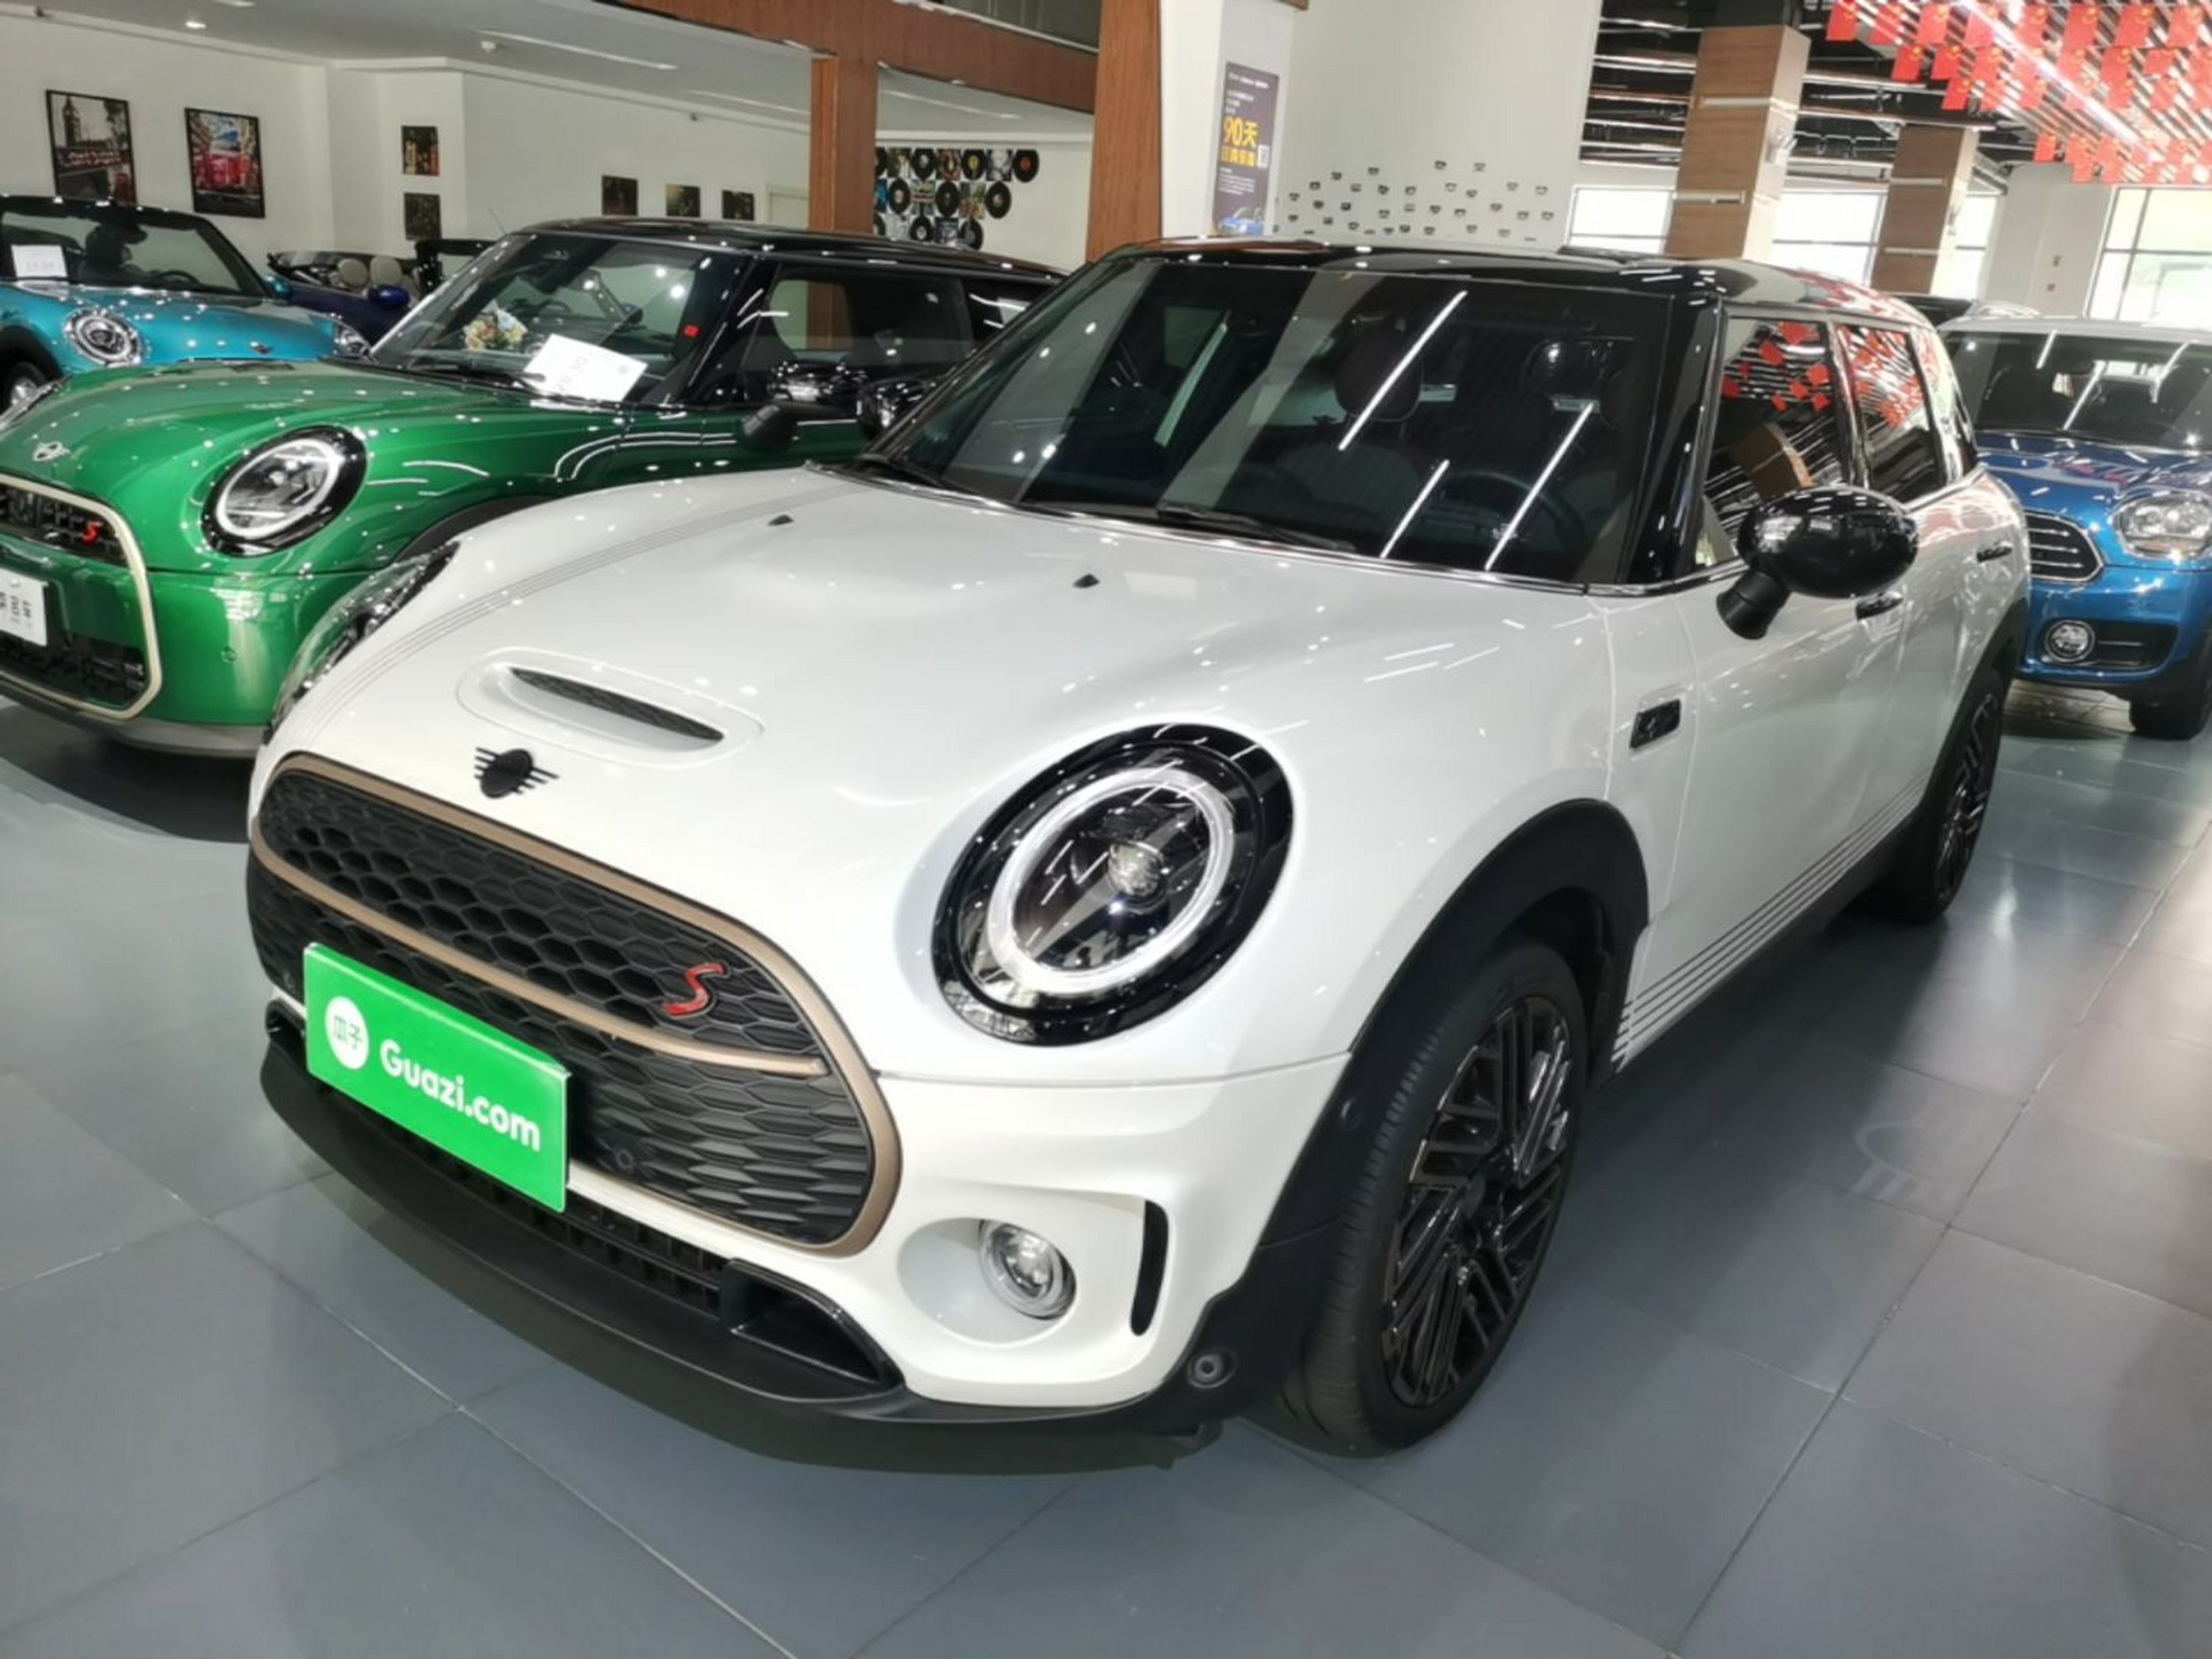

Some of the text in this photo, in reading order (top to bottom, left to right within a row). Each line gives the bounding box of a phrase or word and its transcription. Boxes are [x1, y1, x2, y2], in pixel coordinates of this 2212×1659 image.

[1223, 116, 1257, 148] 90天
[81, 521, 103, 544] S
[664, 963, 729, 1018] S
[380, 1039, 541, 1152] Guazi.com
